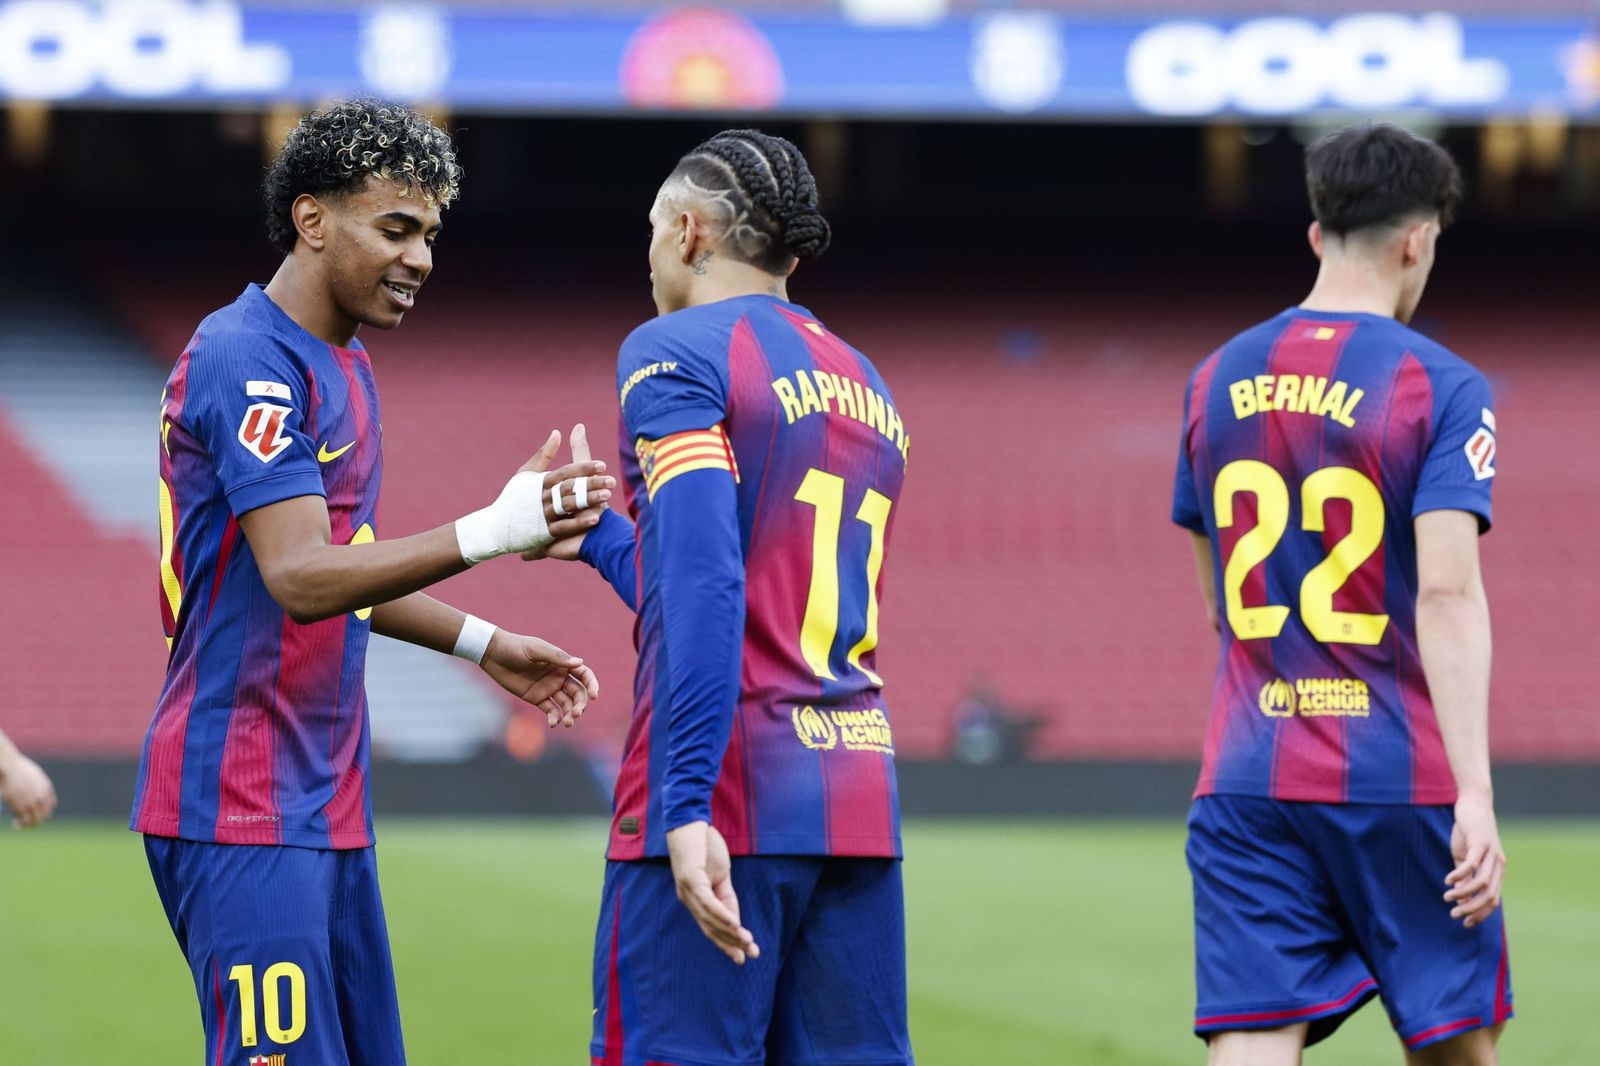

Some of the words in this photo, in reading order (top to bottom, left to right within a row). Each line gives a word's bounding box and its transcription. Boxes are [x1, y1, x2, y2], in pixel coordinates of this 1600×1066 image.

[1229, 374, 1364, 428] BERNAL
[793, 467, 893, 687] 11
[1213, 459, 1390, 646] 22
[1296, 678, 1369, 694] UNHCR
[1299, 694, 1370, 710] ACNUR
[830, 708, 890, 728] UNHC
[228, 961, 307, 1047] 10
